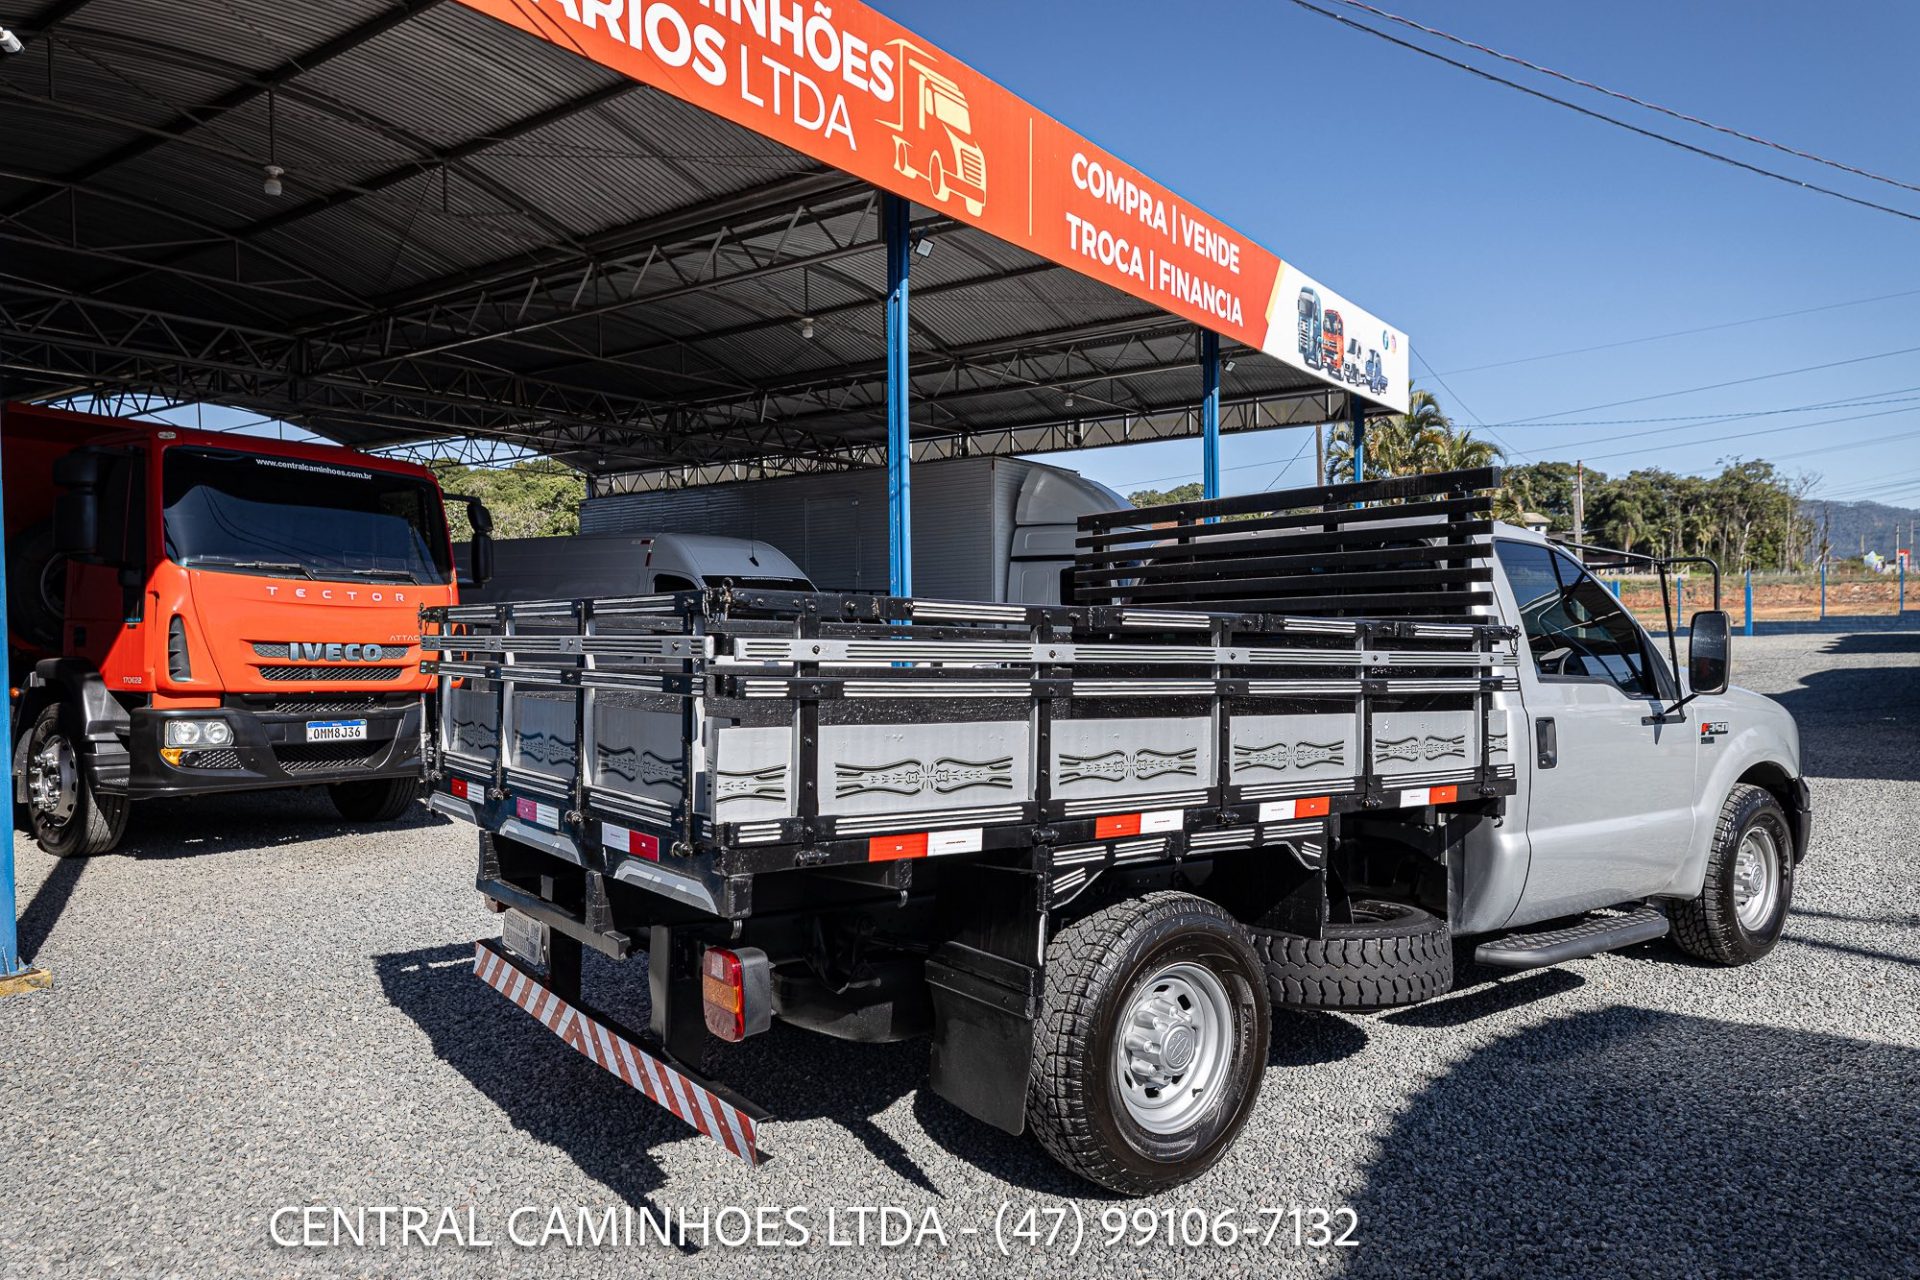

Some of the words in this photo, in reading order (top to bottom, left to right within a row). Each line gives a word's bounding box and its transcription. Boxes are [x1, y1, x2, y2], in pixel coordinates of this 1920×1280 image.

[533, 0, 727, 86] RIOS
[740, 43, 857, 152] LTDA
[699, 0, 895, 102] NHÕES
[1071, 152, 1168, 236] COMPRA
[1180, 212, 1240, 275] VENDE
[1065, 211, 1145, 282] TROCA
[1159, 258, 1244, 327] FINANCIA
[255, 458, 372, 480] www.centralcaminhoes.com.br
[266, 586, 405, 602] TECTOR
[289, 642, 383, 662] IVECO
